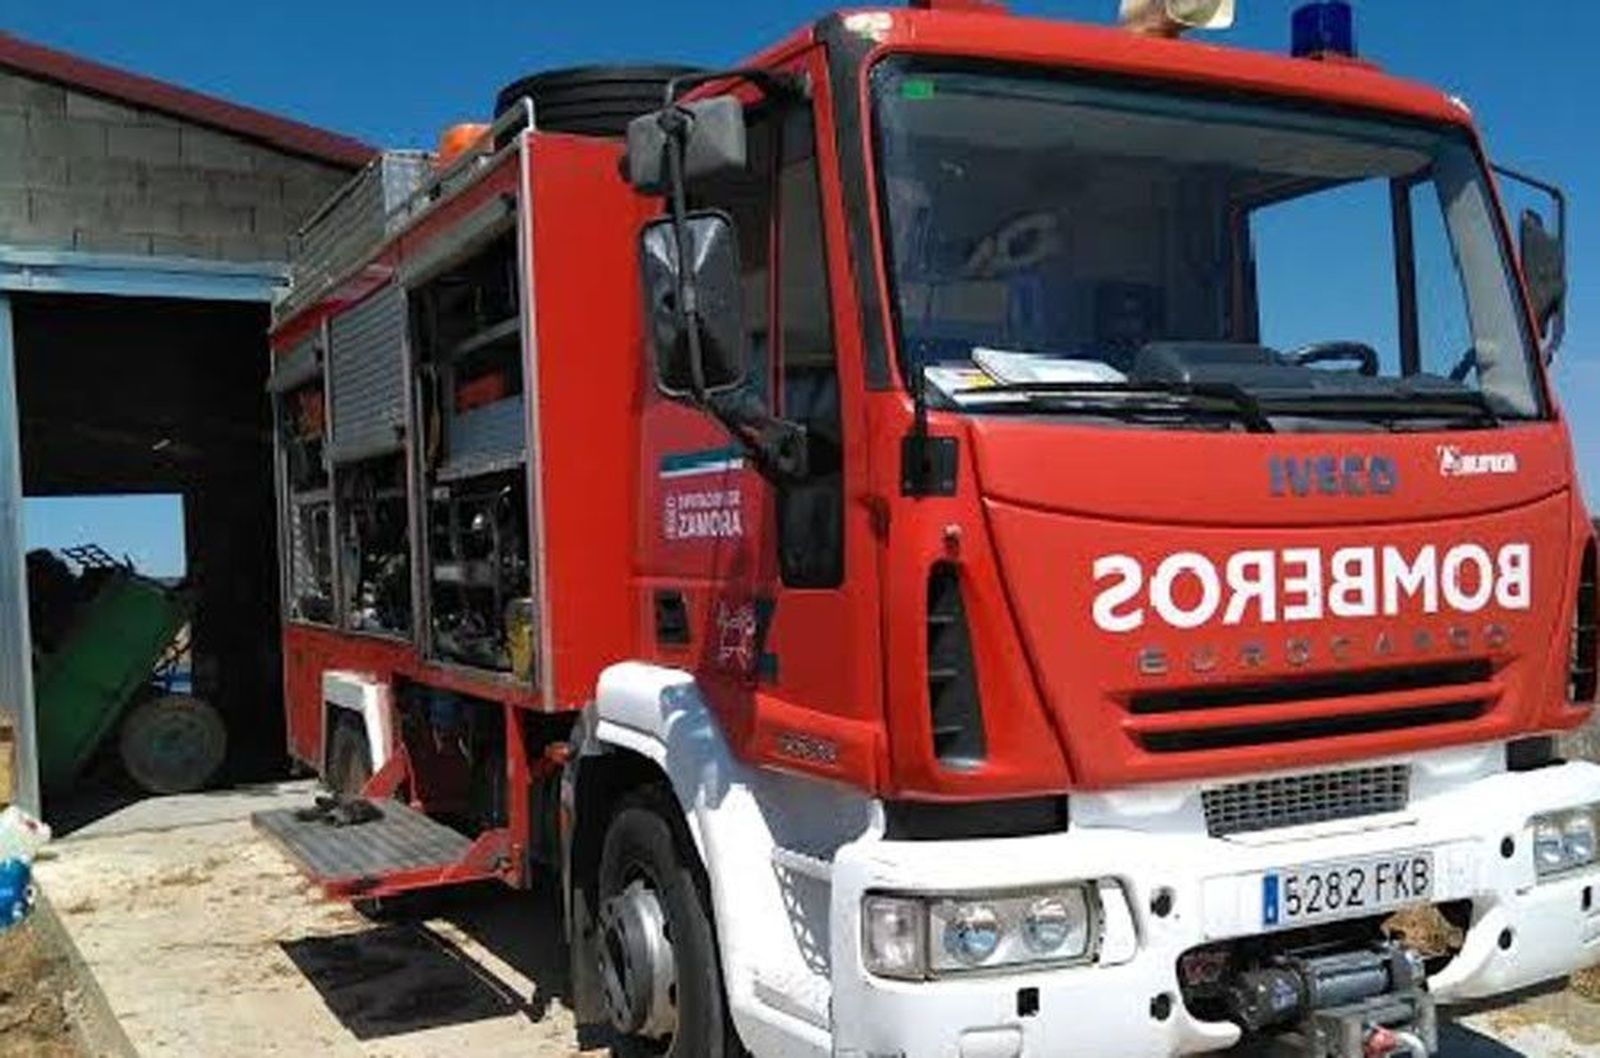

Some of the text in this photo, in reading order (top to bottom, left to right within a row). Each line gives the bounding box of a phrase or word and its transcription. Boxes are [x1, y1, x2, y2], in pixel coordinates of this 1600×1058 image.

[1268, 453, 1398, 496] IVECO
[678, 508, 743, 538] ZAMORA
[1285, 858, 1429, 916] 5282 FKB
